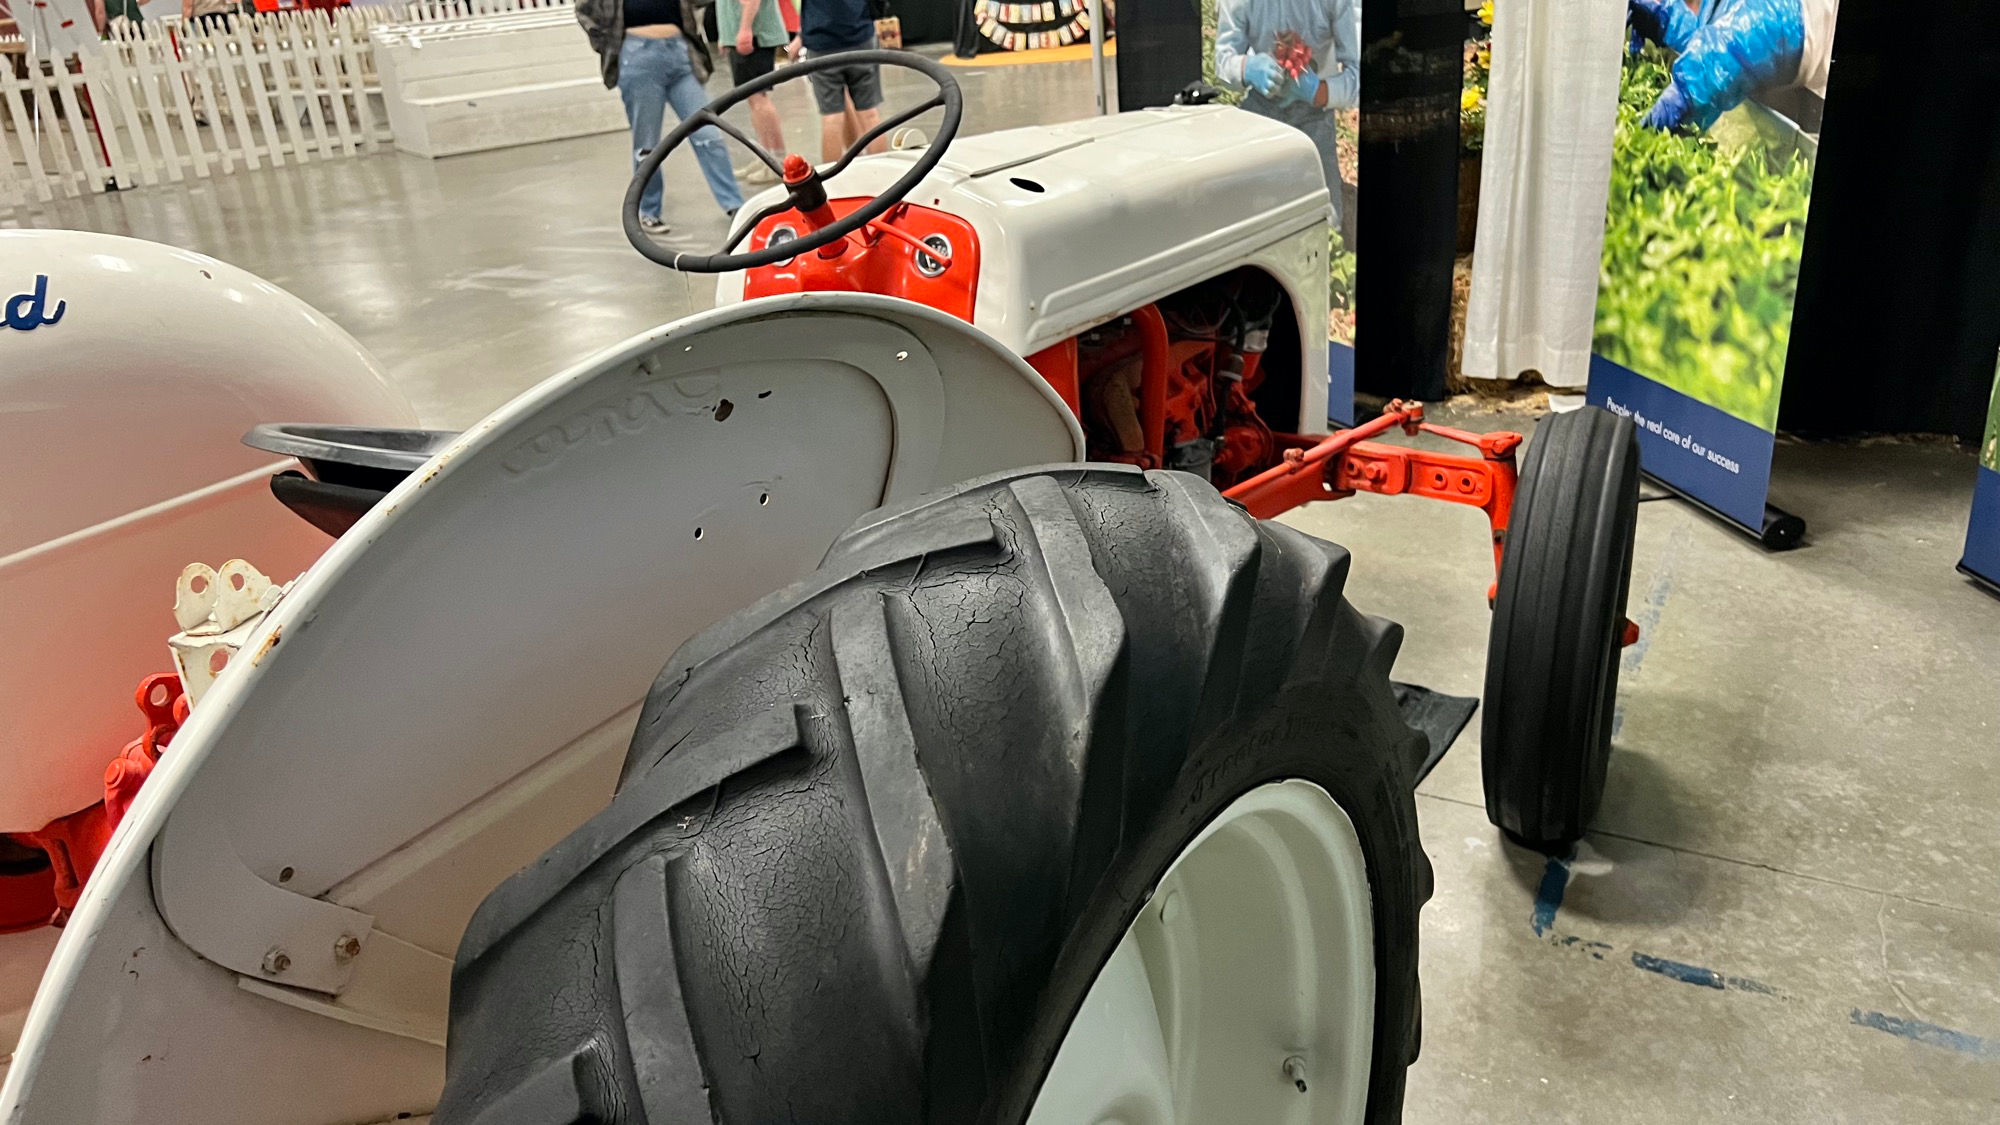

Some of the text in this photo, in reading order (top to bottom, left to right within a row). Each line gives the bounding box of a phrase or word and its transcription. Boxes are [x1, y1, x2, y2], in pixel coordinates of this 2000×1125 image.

[0, 274, 66, 330] d
[1634, 410, 1645, 428] the
[1647, 420, 1663, 435] real
[1681, 434, 1692, 450] of
[1692, 442, 1706, 457] our
[1707, 449, 1739, 474] success
